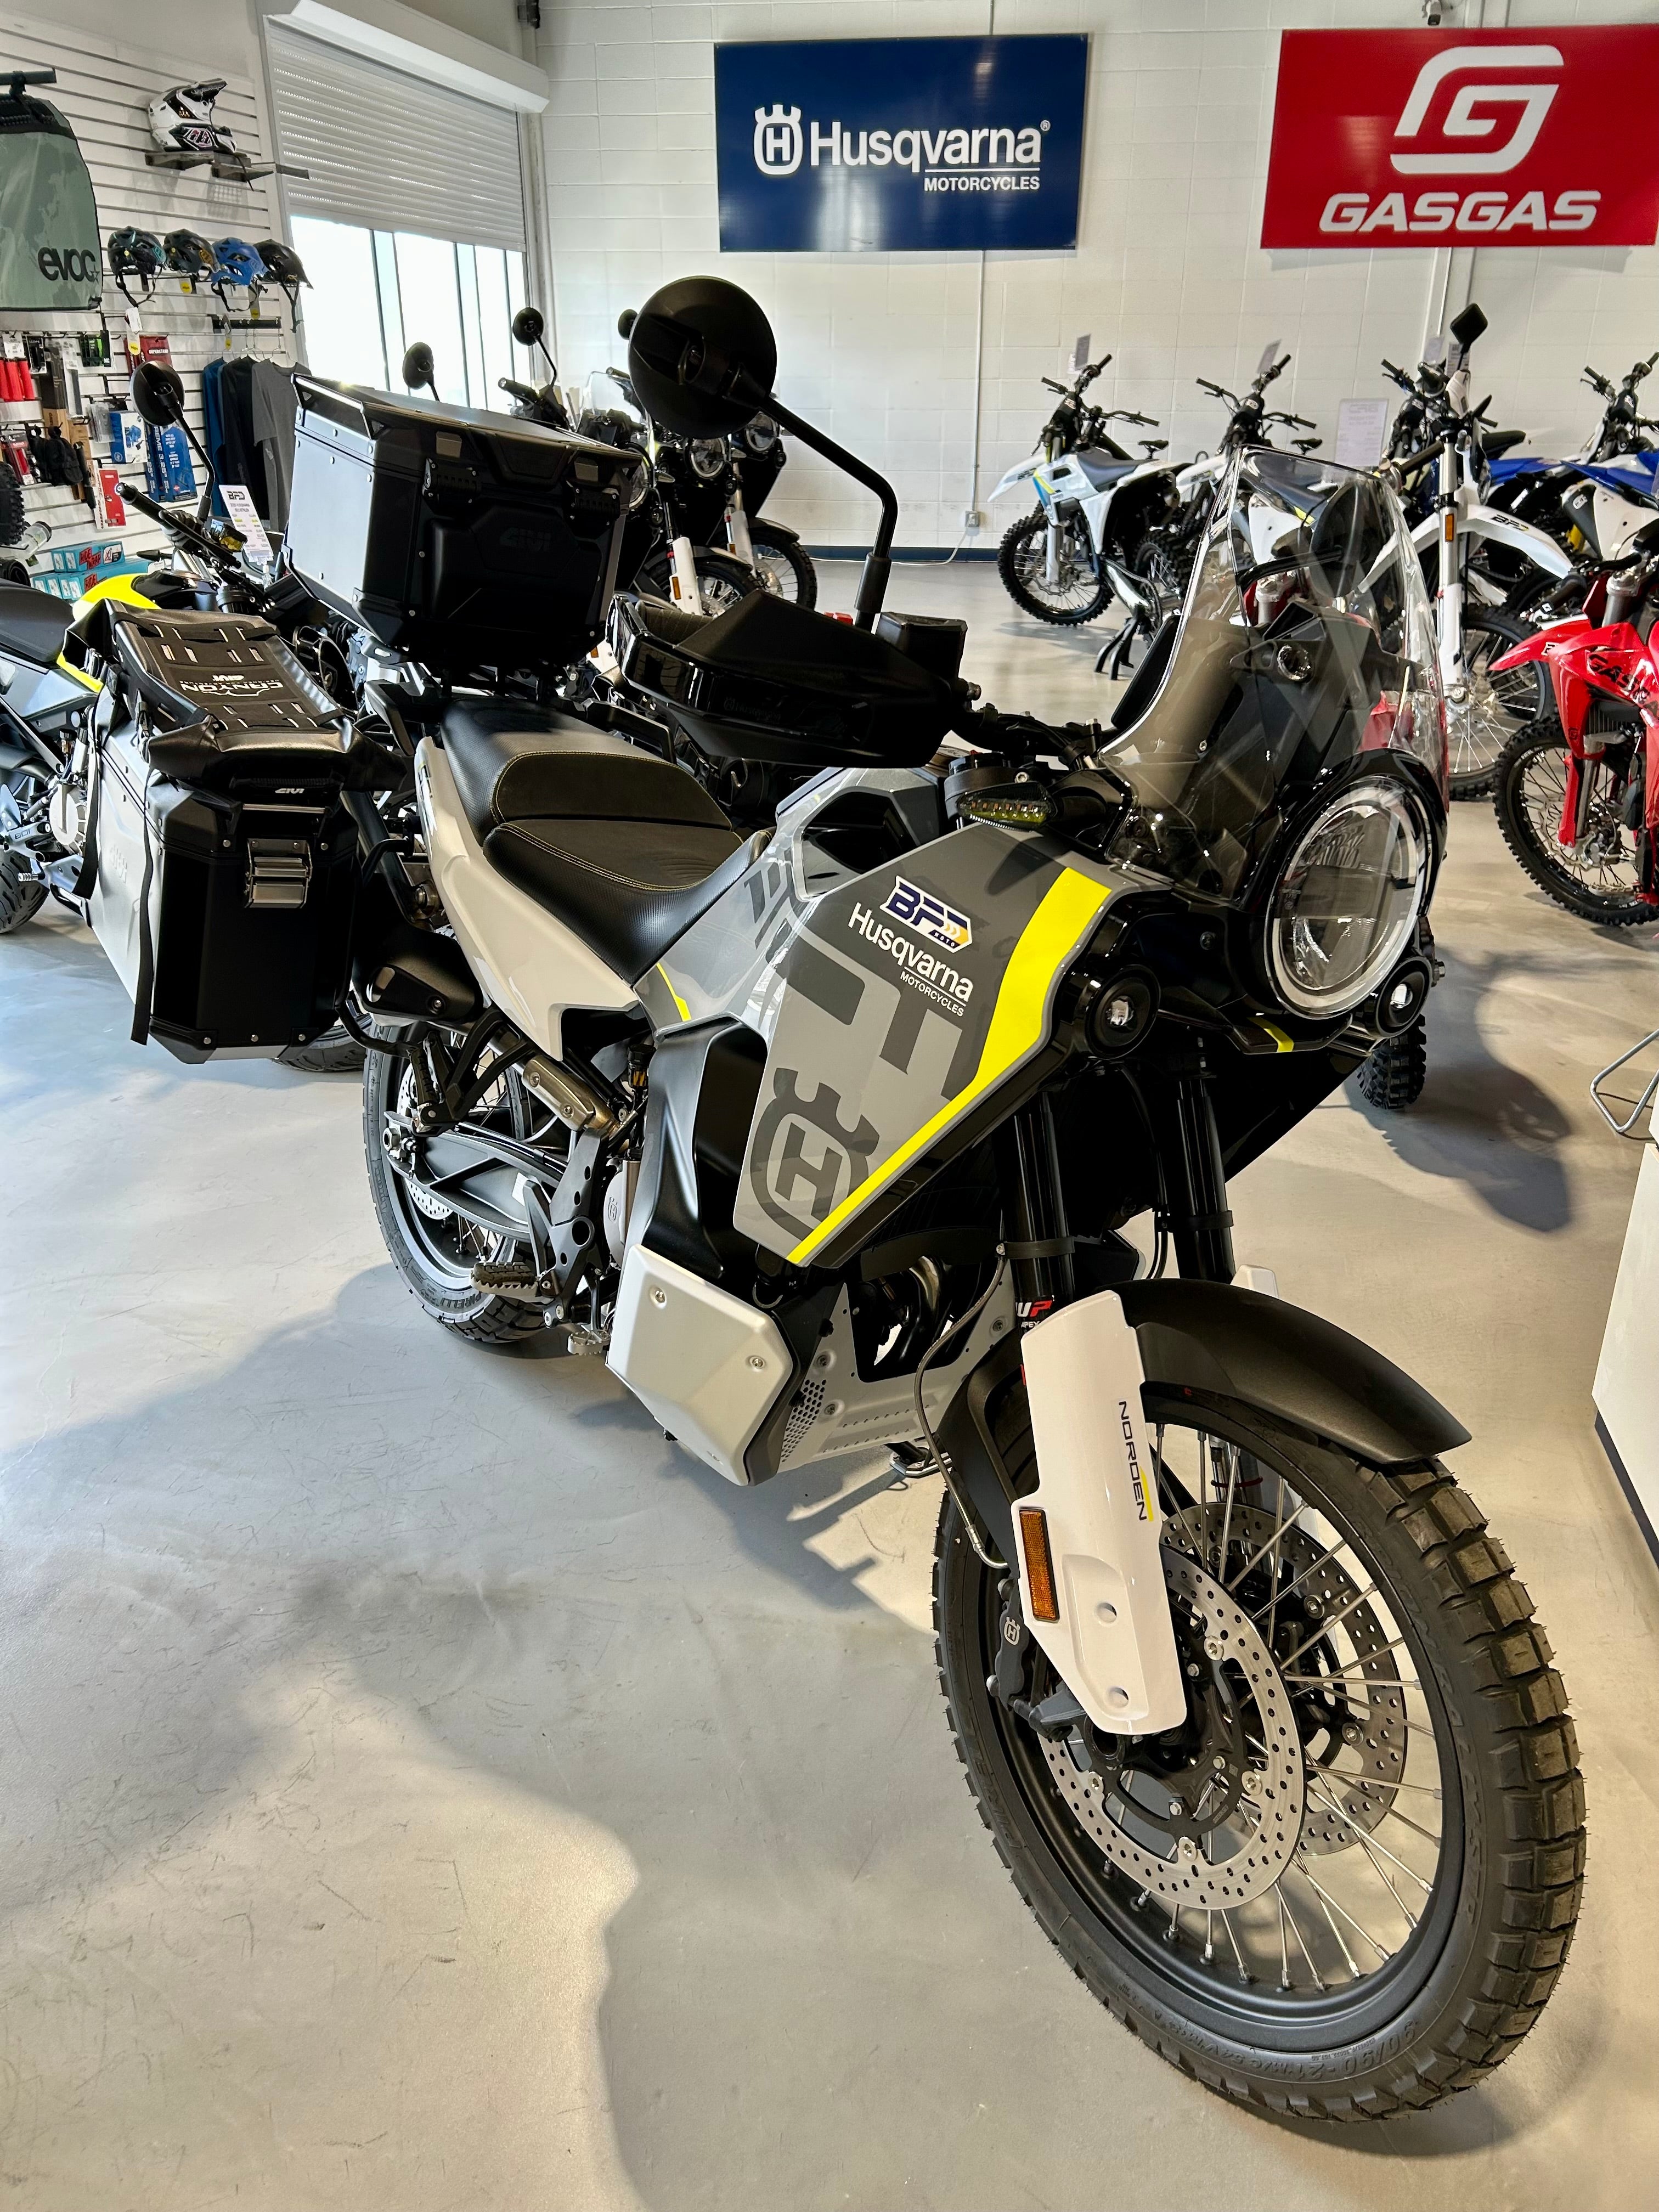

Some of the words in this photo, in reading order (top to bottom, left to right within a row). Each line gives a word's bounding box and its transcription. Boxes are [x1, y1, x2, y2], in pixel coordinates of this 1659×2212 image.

[924, 176, 1040, 191] MOTORCYCLES
[1319, 190, 1601, 233] GASGAS
[38, 247, 96, 282] evoc
[180, 682, 284, 691] CANYON
[848, 901, 974, 1003] Husqvarna
[933, 932, 956, 947] MOTO
[900, 970, 964, 1017] MOTORCYCLES
[1015, 1299, 1053, 1318] WP
[1118, 1400, 1147, 1522] NORDEN
